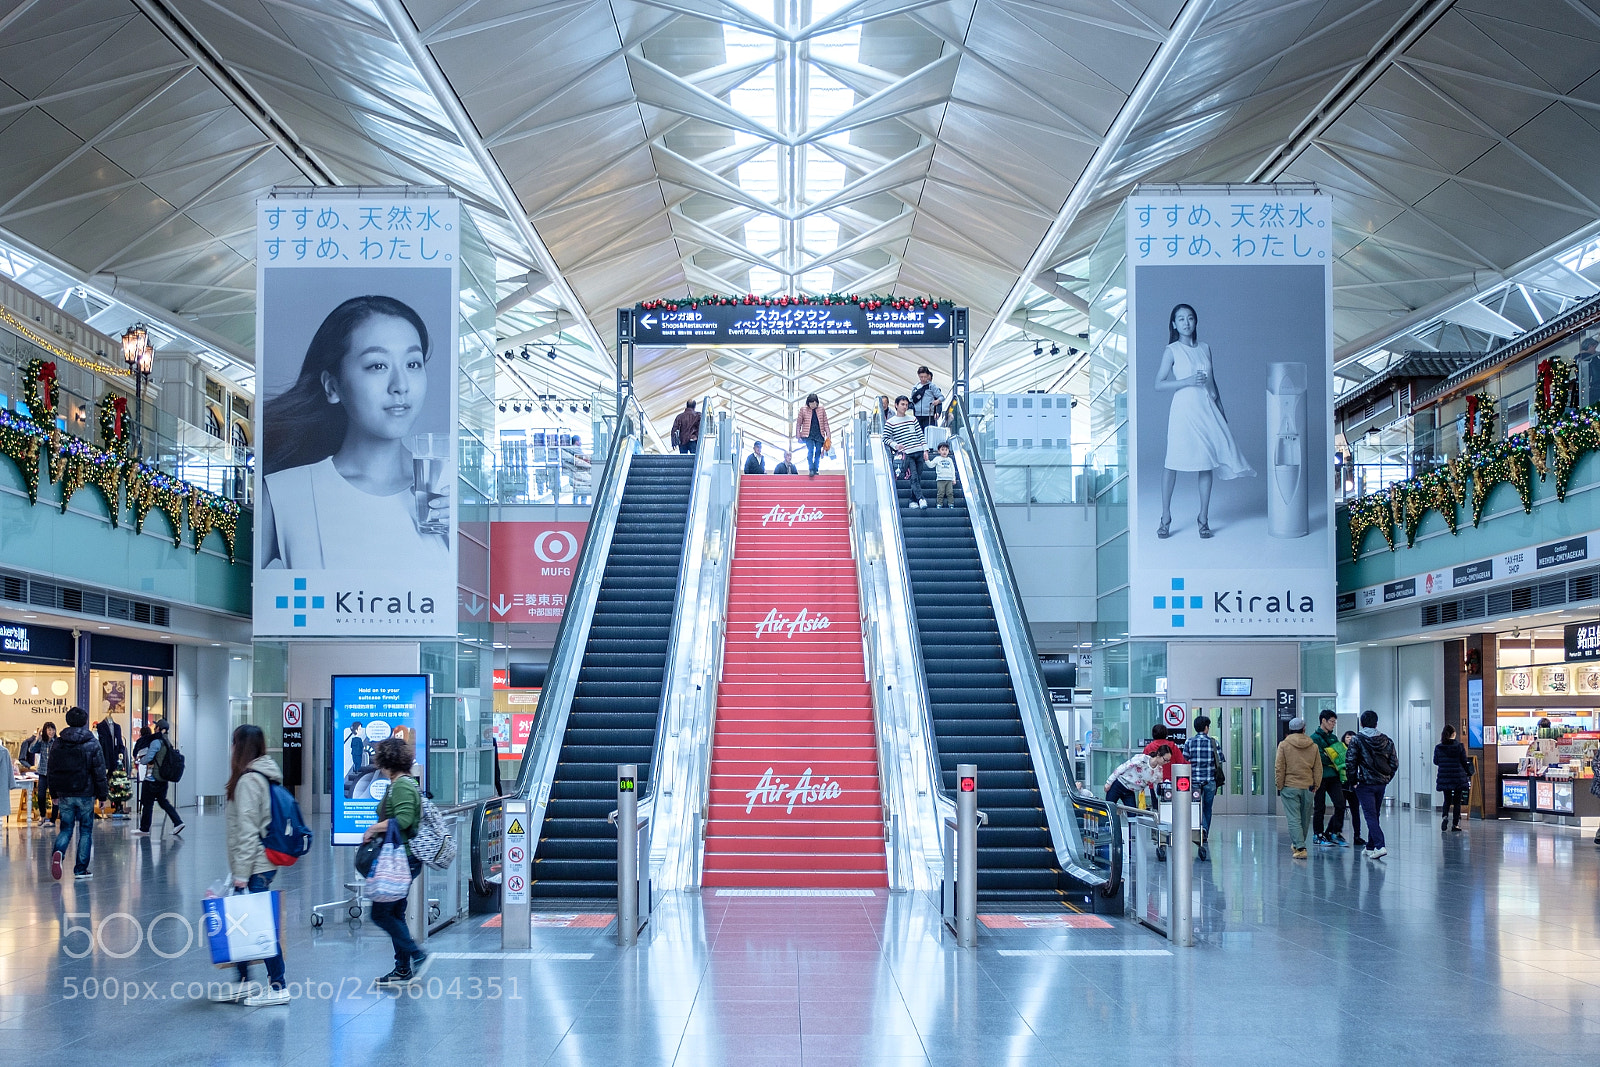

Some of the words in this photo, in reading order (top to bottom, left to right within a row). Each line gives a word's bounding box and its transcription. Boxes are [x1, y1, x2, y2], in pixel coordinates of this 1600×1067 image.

[264, 205, 453, 231] すすめ、天然水。
[1134, 202, 1326, 229] すすめ、天然水。
[264, 236, 453, 261] すすめ、わたし。
[1134, 233, 1326, 259] すすめ、わたし。
[661, 312, 703, 321] レンガ通り
[755, 309, 831, 321] スカイタウン
[865, 312, 925, 321] ちょうちん横丁
[661, 322, 718, 330] Shops&Restaurants
[734, 320, 853, 329] イベントプラザ・スカイデッキ
[868, 322, 925, 330] Shops&Restaurants
[1504, 553, 1524, 565] TAX-FREE
[541, 567, 571, 577] MUFG
[1508, 564, 1520, 575] SHOP
[336, 590, 435, 614] Kirala
[1214, 589, 1314, 613] Kirala
[1577, 624, 1600, 650] 銘品
[1279, 691, 1294, 705] 3F
[31, 706, 58, 714] Shirt
